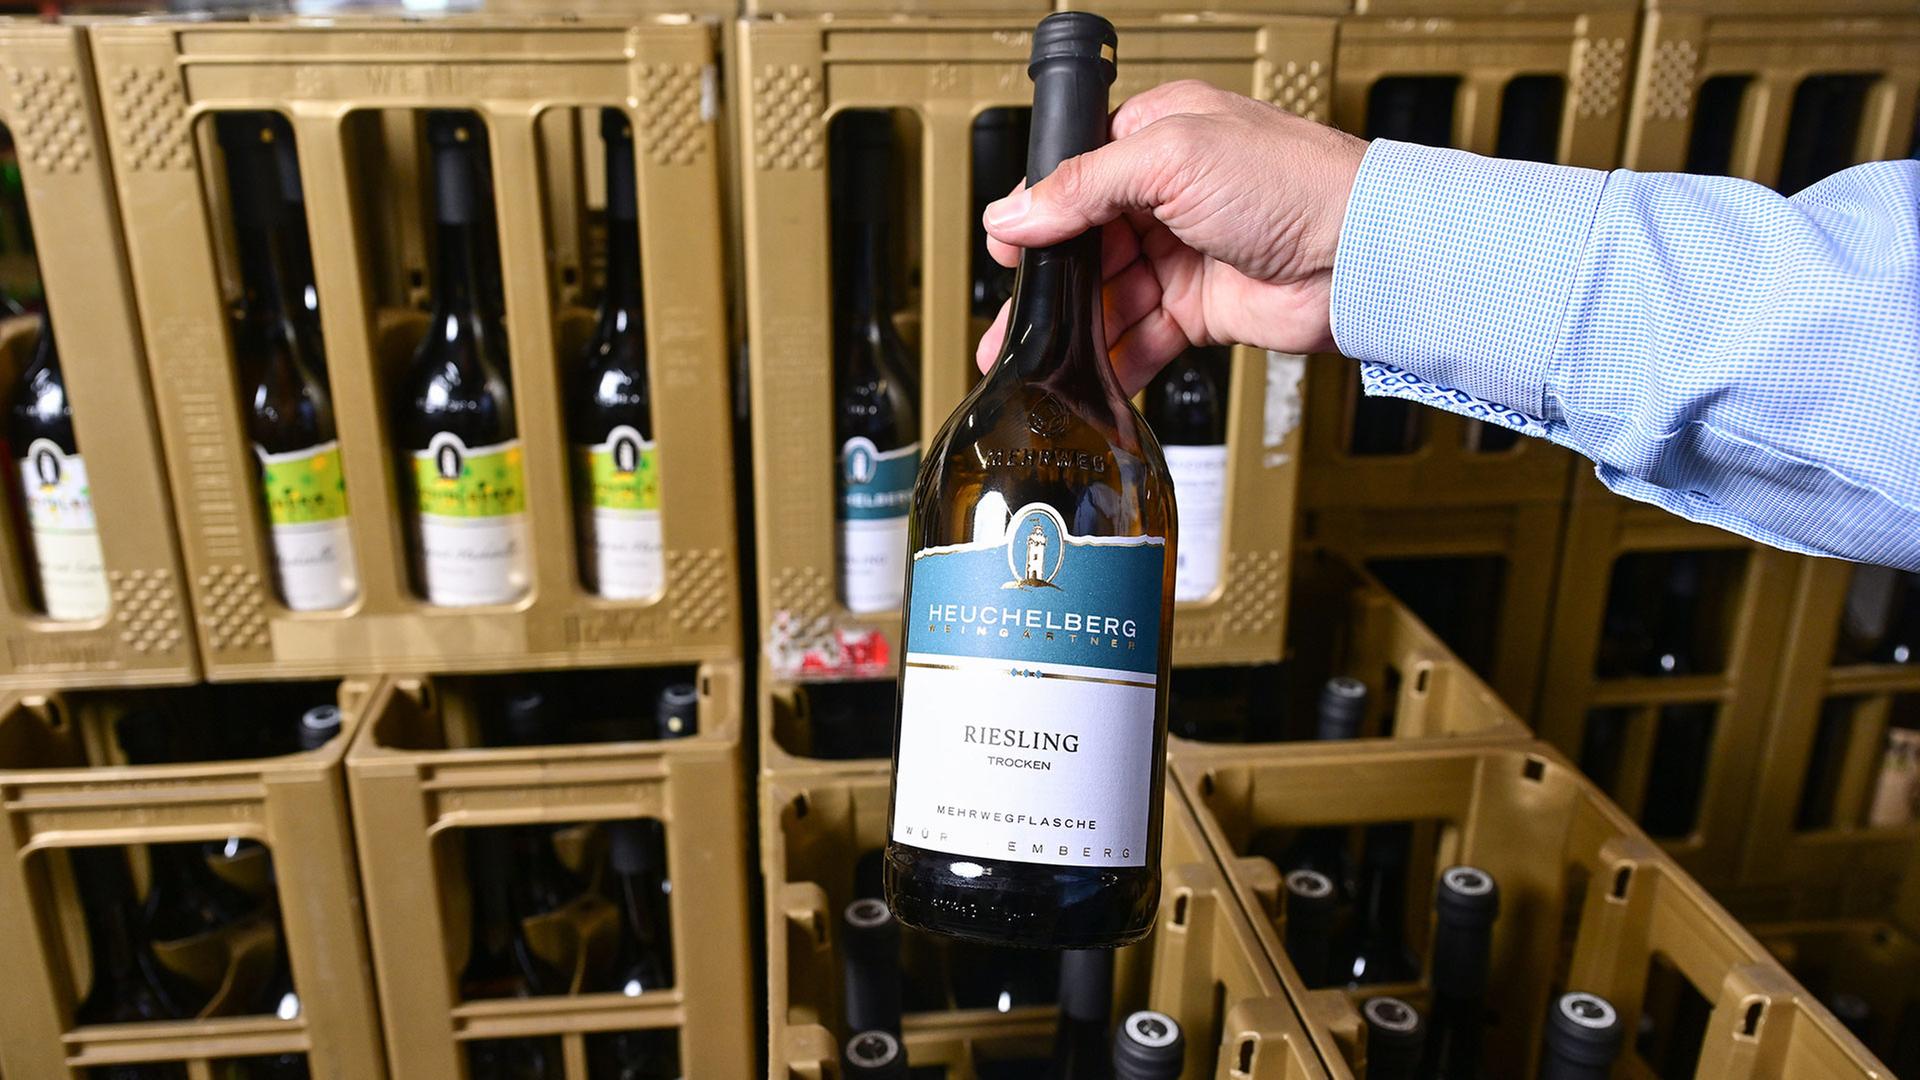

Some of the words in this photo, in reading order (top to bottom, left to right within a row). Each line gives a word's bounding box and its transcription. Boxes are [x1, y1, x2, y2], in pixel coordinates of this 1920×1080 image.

[986, 450, 1105, 473] MEHRWEG
[928, 603, 1137, 638] HEUCHELBERG
[963, 725, 1079, 753] RIESLING
[987, 755, 1051, 771] TROCKEN
[936, 805, 1097, 830] MEHRWEGFLASCHE
[905, 825, 1132, 859] WÜREMBERG
